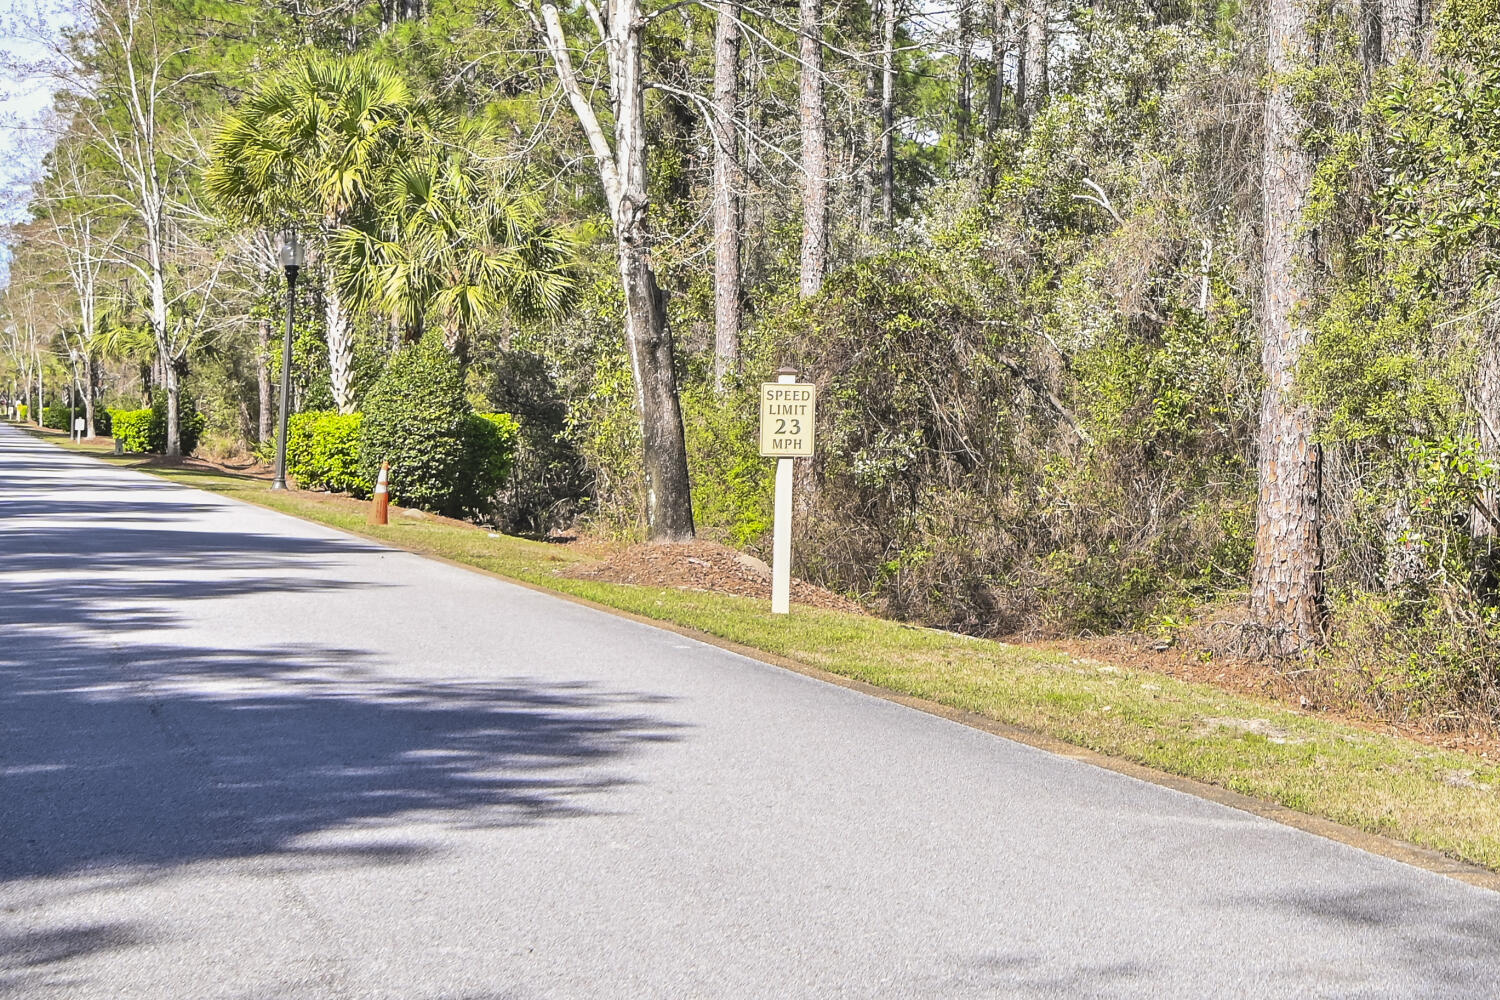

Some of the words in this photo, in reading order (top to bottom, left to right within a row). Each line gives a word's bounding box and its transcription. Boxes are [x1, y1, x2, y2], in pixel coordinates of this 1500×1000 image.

[766, 390, 811, 401] SPEED
[769, 404, 807, 415] LIMIT
[774, 418, 801, 435] 23
[772, 439, 803, 450] MPH
